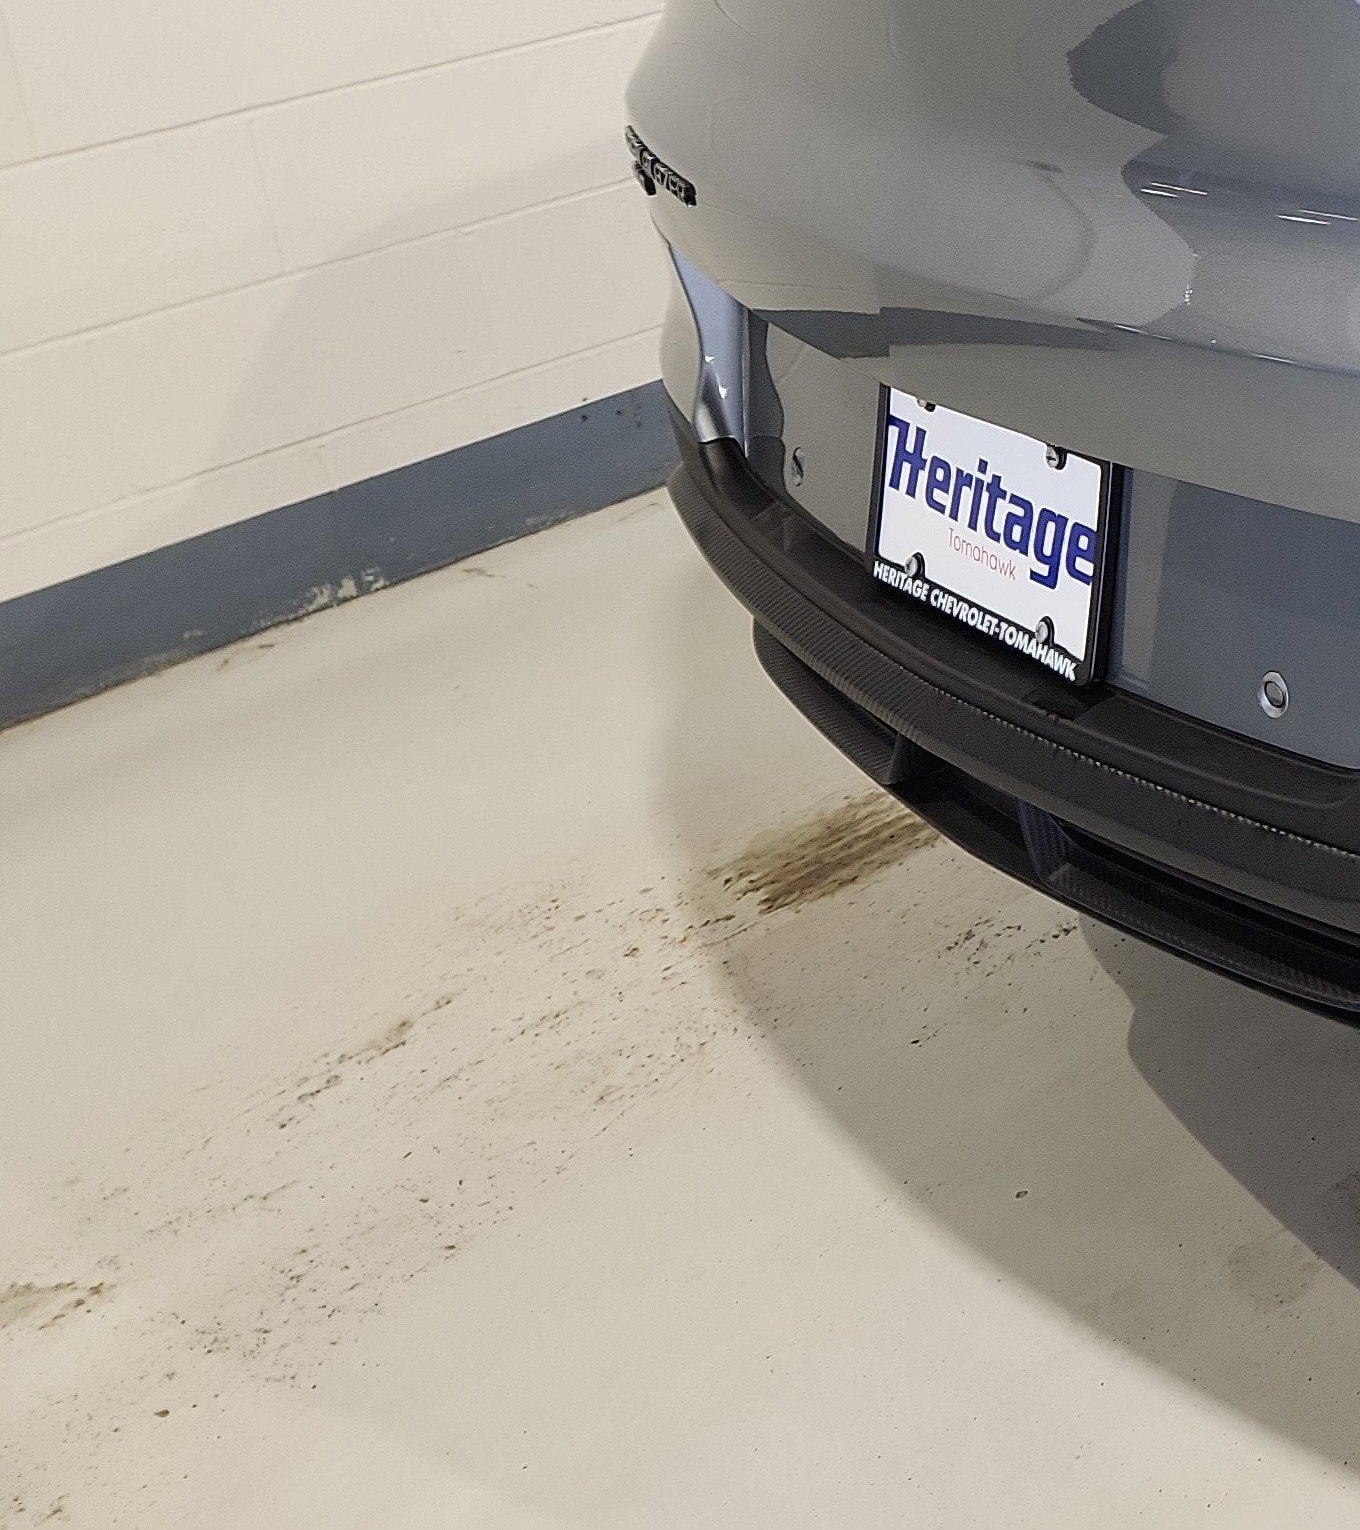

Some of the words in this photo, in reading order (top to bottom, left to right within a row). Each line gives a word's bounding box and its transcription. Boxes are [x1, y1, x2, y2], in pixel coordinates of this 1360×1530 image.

[886, 414, 1096, 590] Heritage
[949, 528, 1017, 581] Tomahawk
[874, 562, 929, 601] HERITAGE
[930, 590, 1077, 682] CHEVROLET-TOMAHAWK
